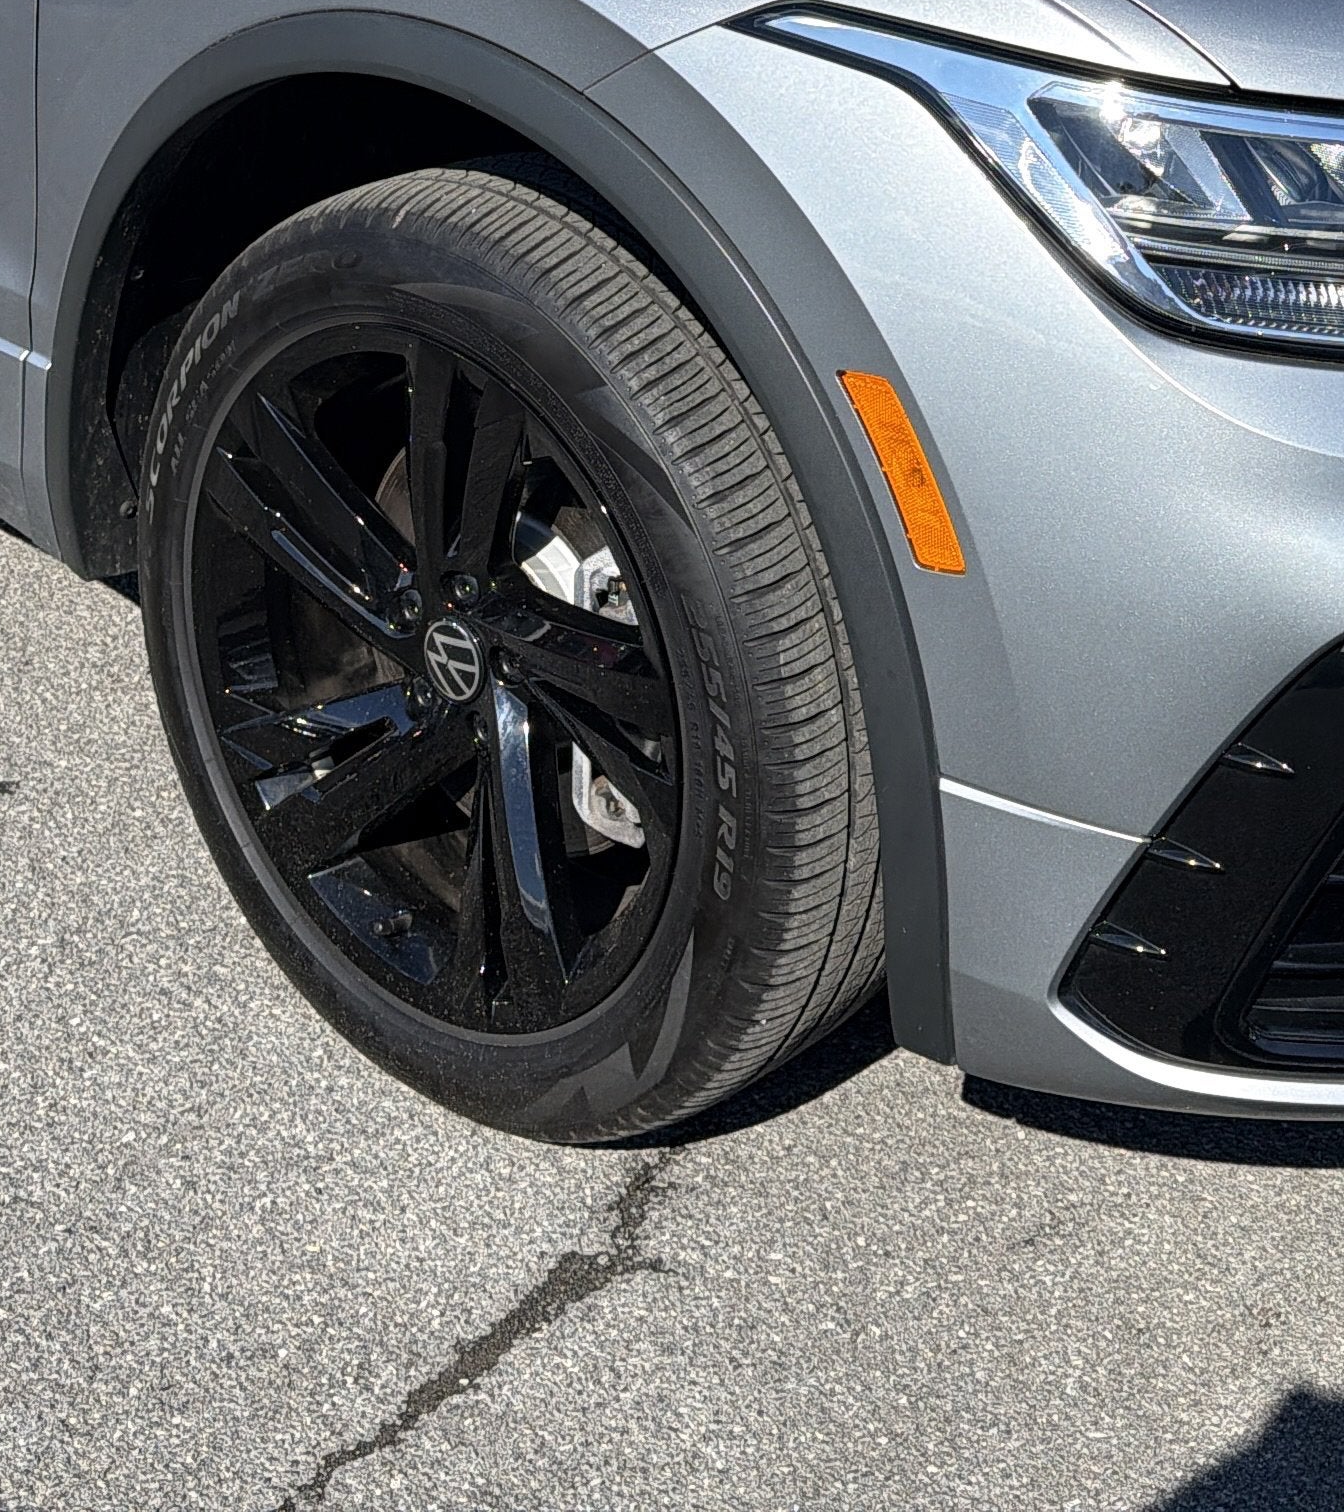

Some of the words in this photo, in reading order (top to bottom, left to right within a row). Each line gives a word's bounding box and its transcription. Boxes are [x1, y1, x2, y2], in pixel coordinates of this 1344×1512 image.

[144, 289, 240, 526] SCORPION
[681, 594, 737, 798] 255/45
[714, 804, 737, 900] R19
